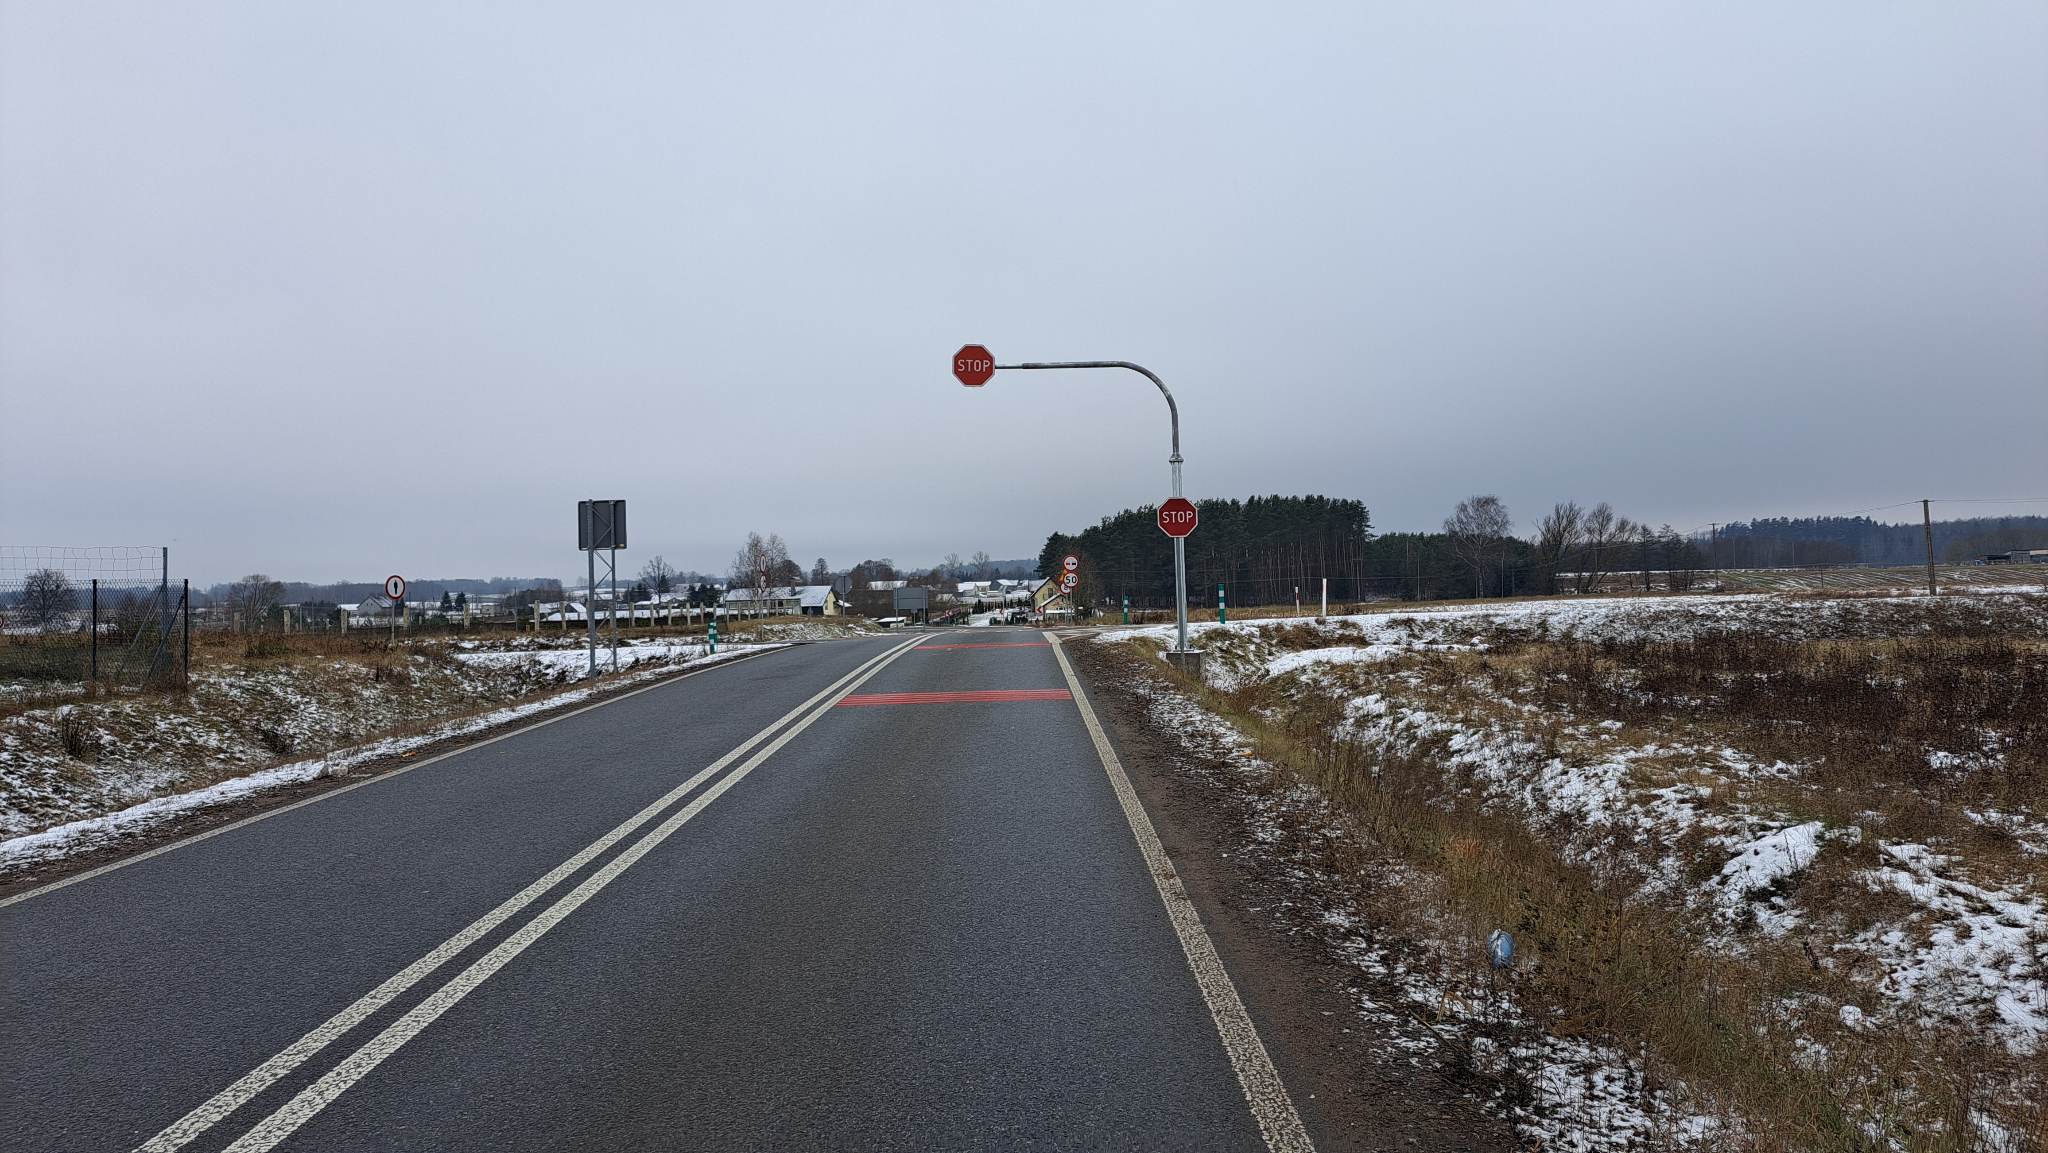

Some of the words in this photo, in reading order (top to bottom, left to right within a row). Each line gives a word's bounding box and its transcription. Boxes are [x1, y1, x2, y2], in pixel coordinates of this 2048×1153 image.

[958, 359, 990, 372] STOP
[1162, 511, 1194, 523] STOP
[1066, 576, 1077, 584] 50
